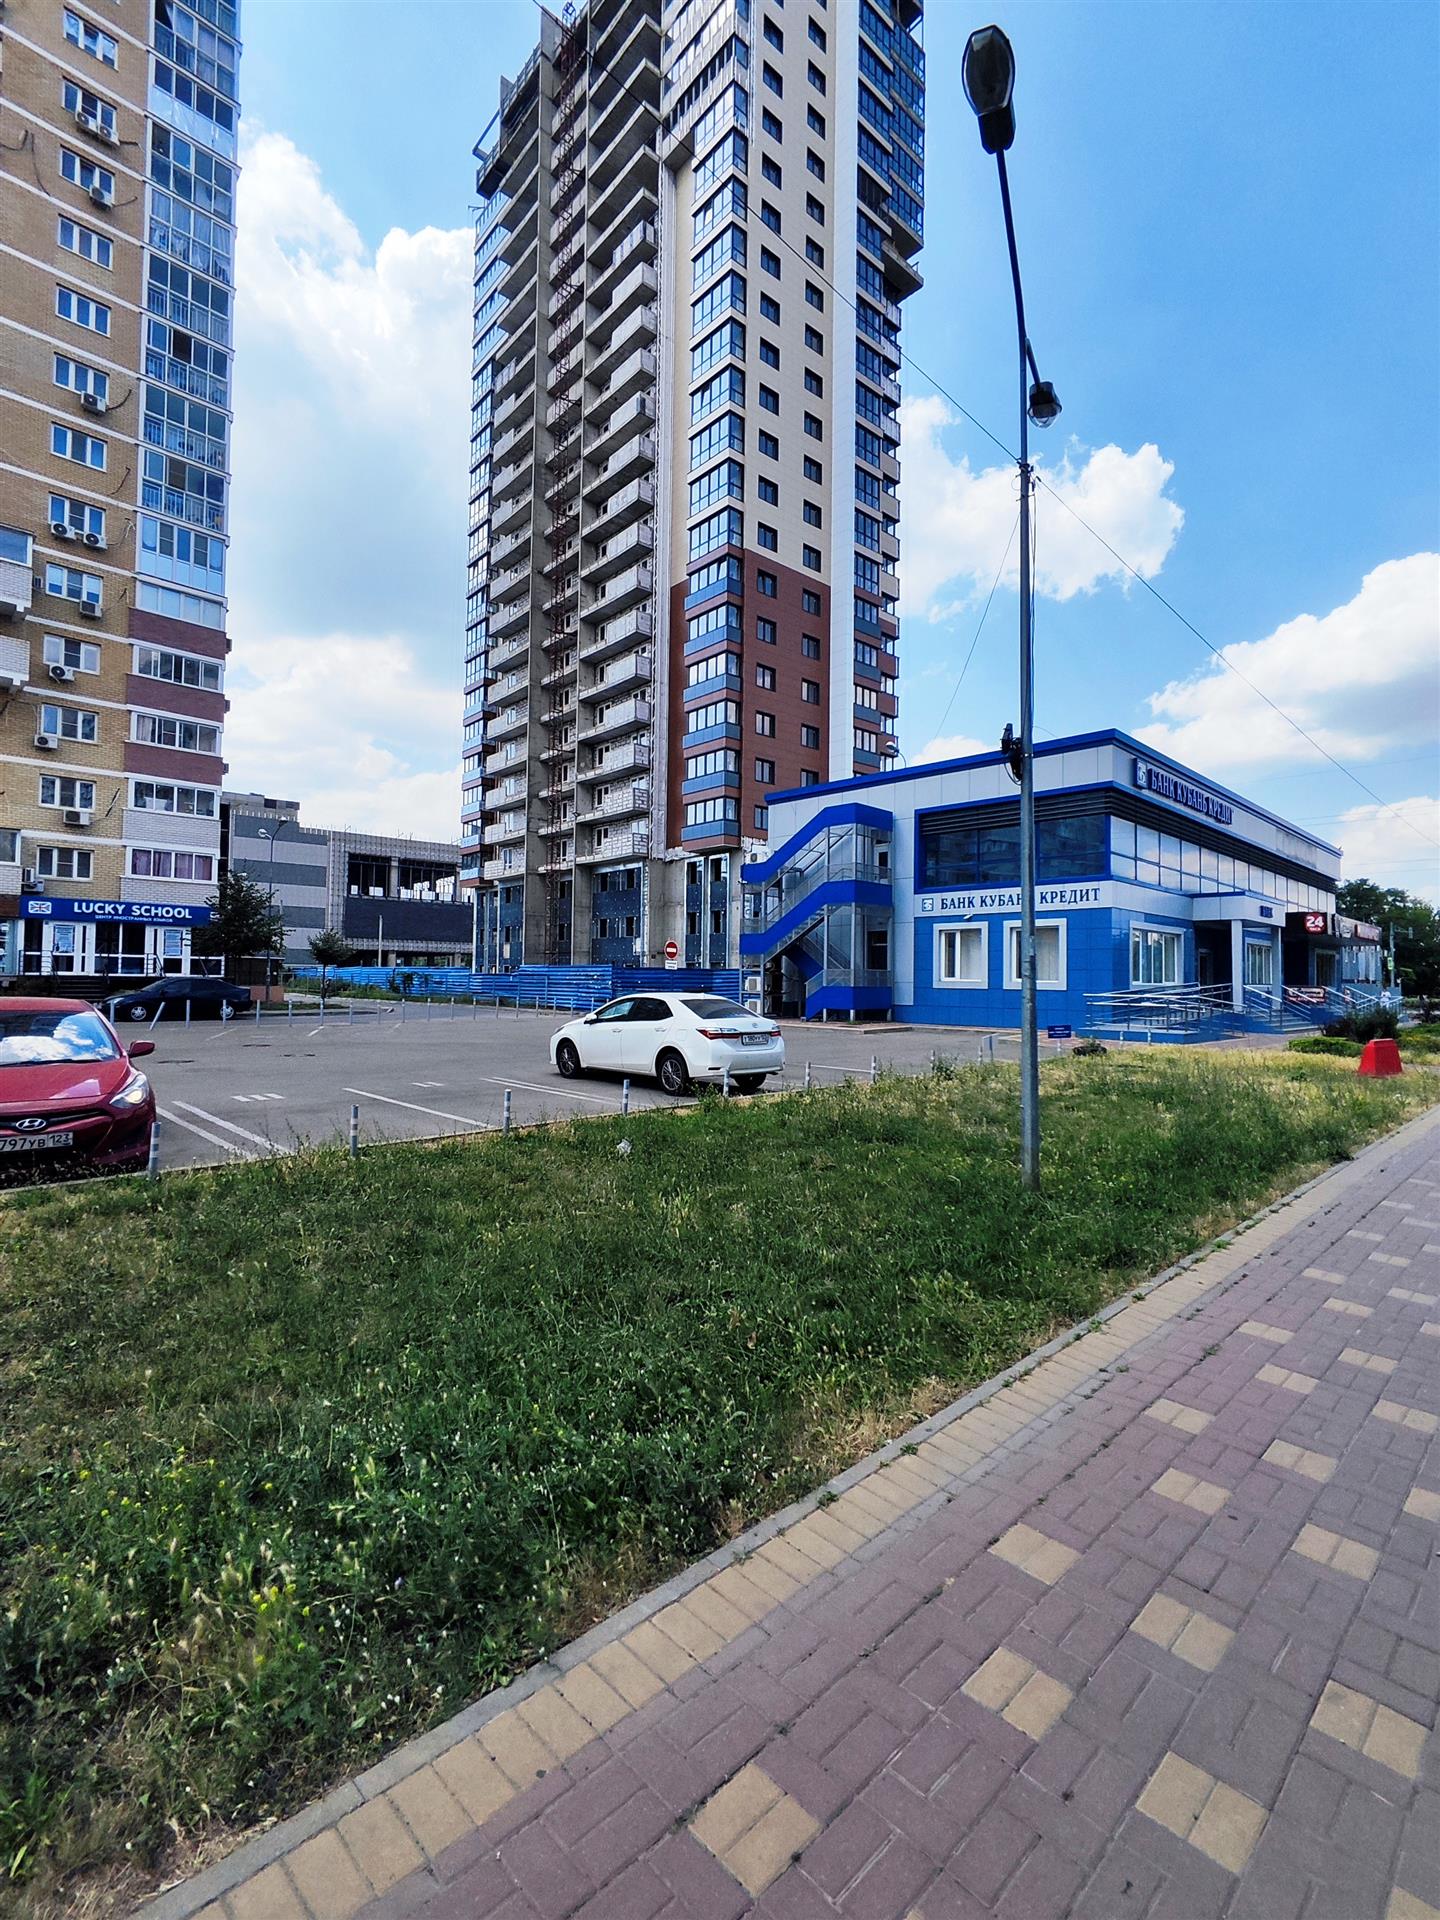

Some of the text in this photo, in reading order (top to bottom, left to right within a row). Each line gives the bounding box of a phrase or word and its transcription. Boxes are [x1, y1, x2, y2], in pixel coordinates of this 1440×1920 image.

[1151, 768, 1175, 798] БАНК
[1176, 781, 1208, 813] КУБАНЬ
[940, 887, 1101, 910] БАНК КУБАН КРЕДИТ
[73, 901, 126, 915] LUCKY
[131, 905, 193, 919] SCHOOL
[1306, 915, 1324, 928] 24
[49, 1133, 71, 1145] 123
